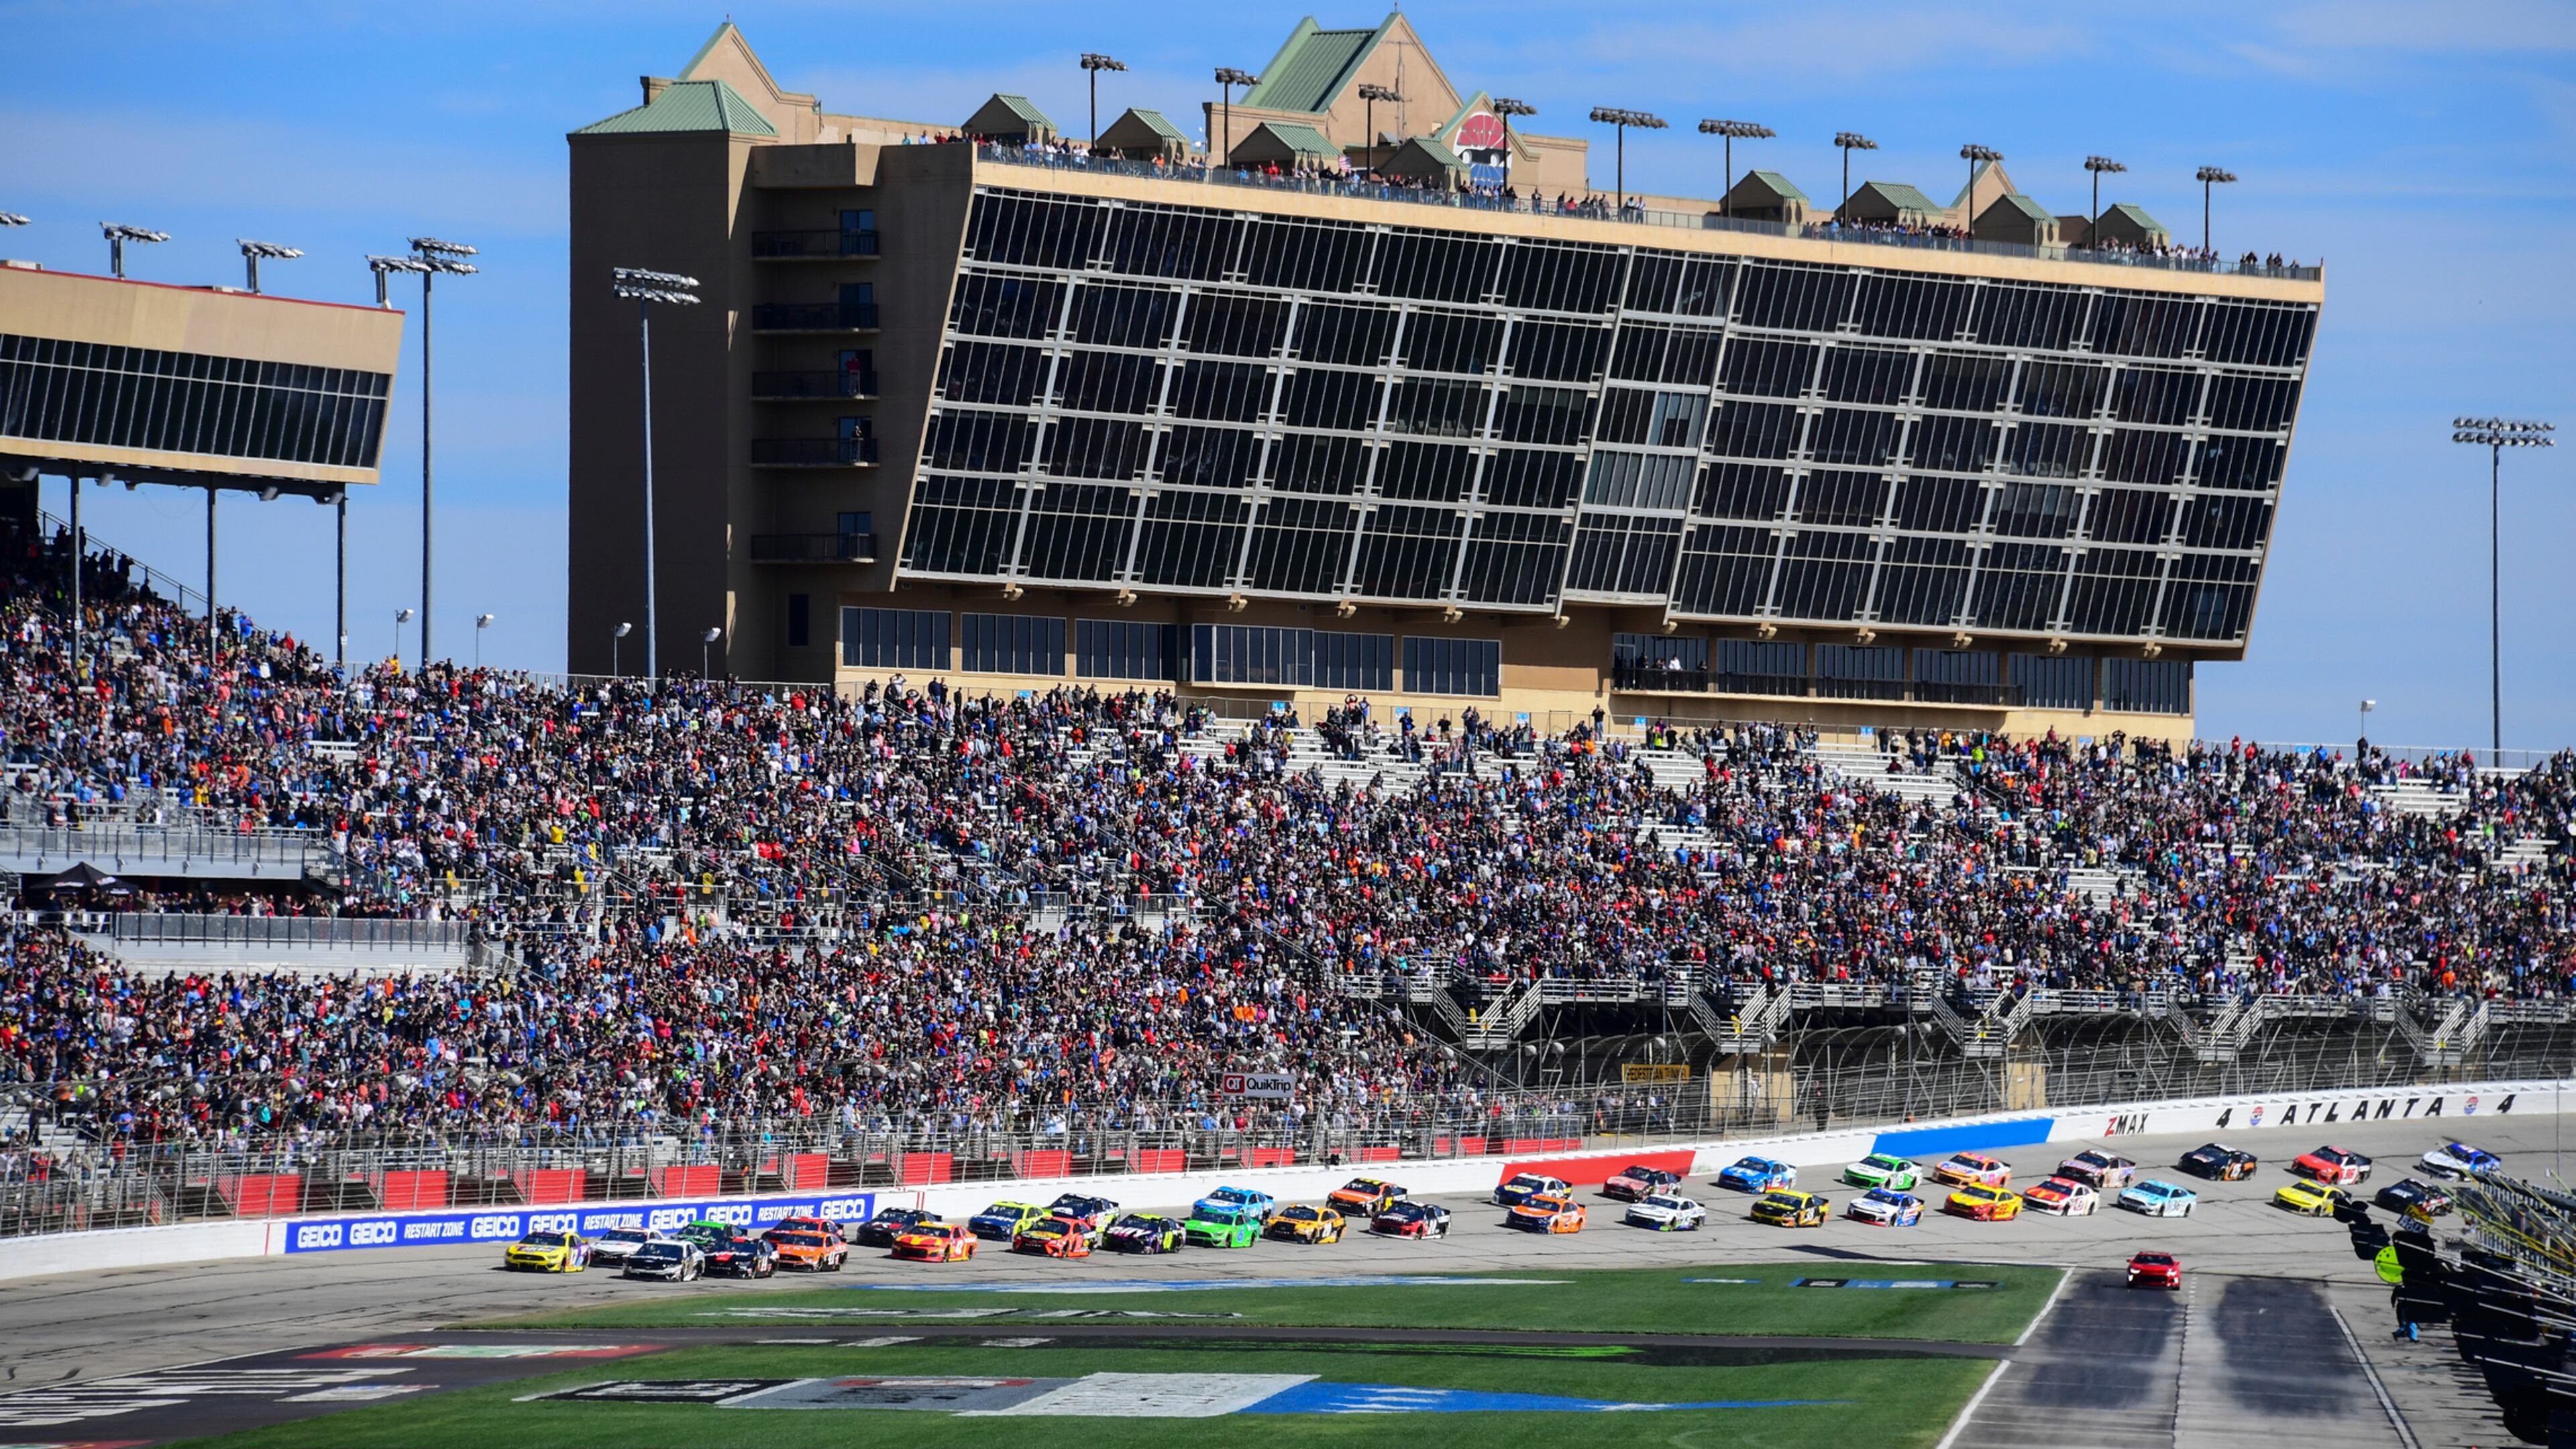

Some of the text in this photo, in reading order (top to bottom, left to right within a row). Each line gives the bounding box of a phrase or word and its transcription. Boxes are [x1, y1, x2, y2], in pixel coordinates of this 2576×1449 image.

[1226, 1077, 1242, 1091] QT
[1246, 1077, 1291, 1092] QuikTrip
[2216, 1108, 2233, 1128] 4
[2279, 1095, 2444, 1125] ATLANTA
[2497, 1094, 2516, 1114] 4
[2104, 1113, 2149, 1137] ZMAX
[297, 1224, 342, 1248] GEICO
[350, 1221, 397, 1246] GEICO
[404, 1224, 441, 1239] RESTART
[441, 1221, 464, 1237] ZONE
[471, 1216, 520, 1238] GEICO
[584, 1214, 622, 1230] RESTART
[622, 1214, 643, 1228] ZONE
[649, 1208, 697, 1230] GEICO
[705, 1205, 753, 1226] GEICO
[757, 1206, 793, 1222] RESTART
[820, 1198, 866, 1220] GEICO
